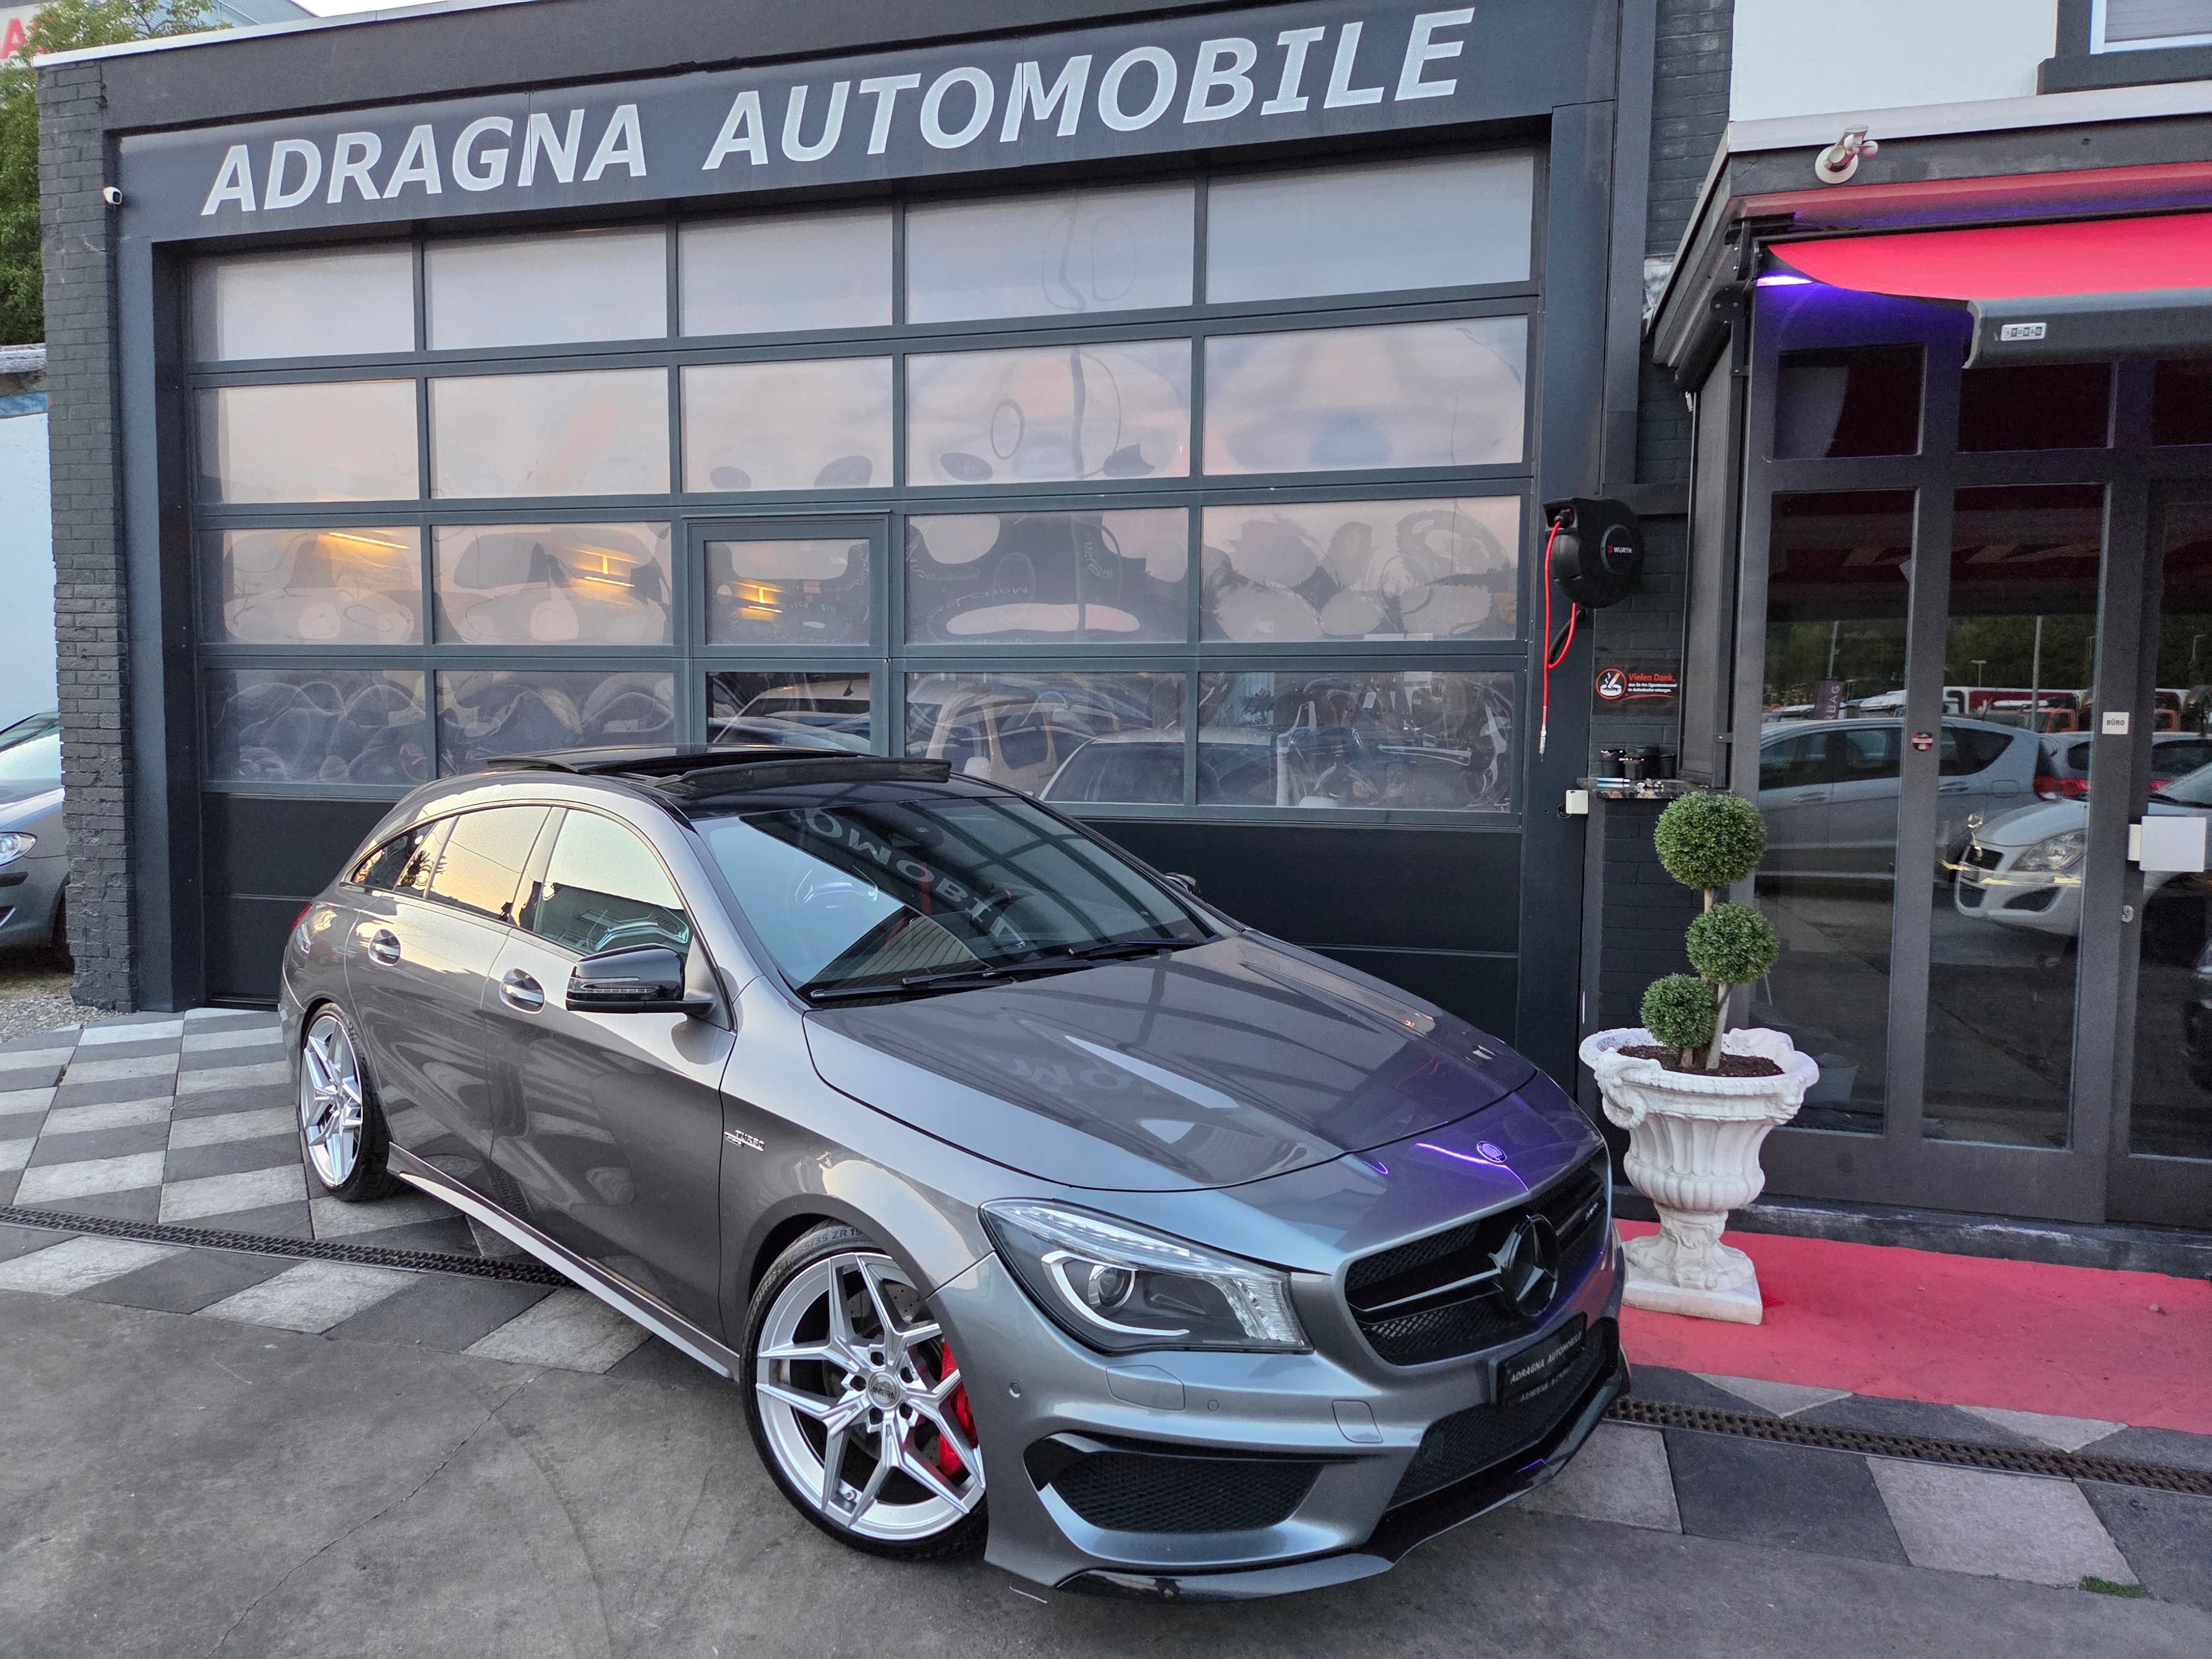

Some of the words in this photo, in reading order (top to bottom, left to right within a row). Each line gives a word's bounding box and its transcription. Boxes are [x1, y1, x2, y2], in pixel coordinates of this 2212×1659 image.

[200, 103, 648, 216] ADRAGNA
[701, 7, 1475, 171] AUTOMOBILE
[1628, 673, 1652, 681] Vielen
[832, 1229, 847, 1240] ZR
[1510, 1358, 1545, 1384] ADRAGNA
